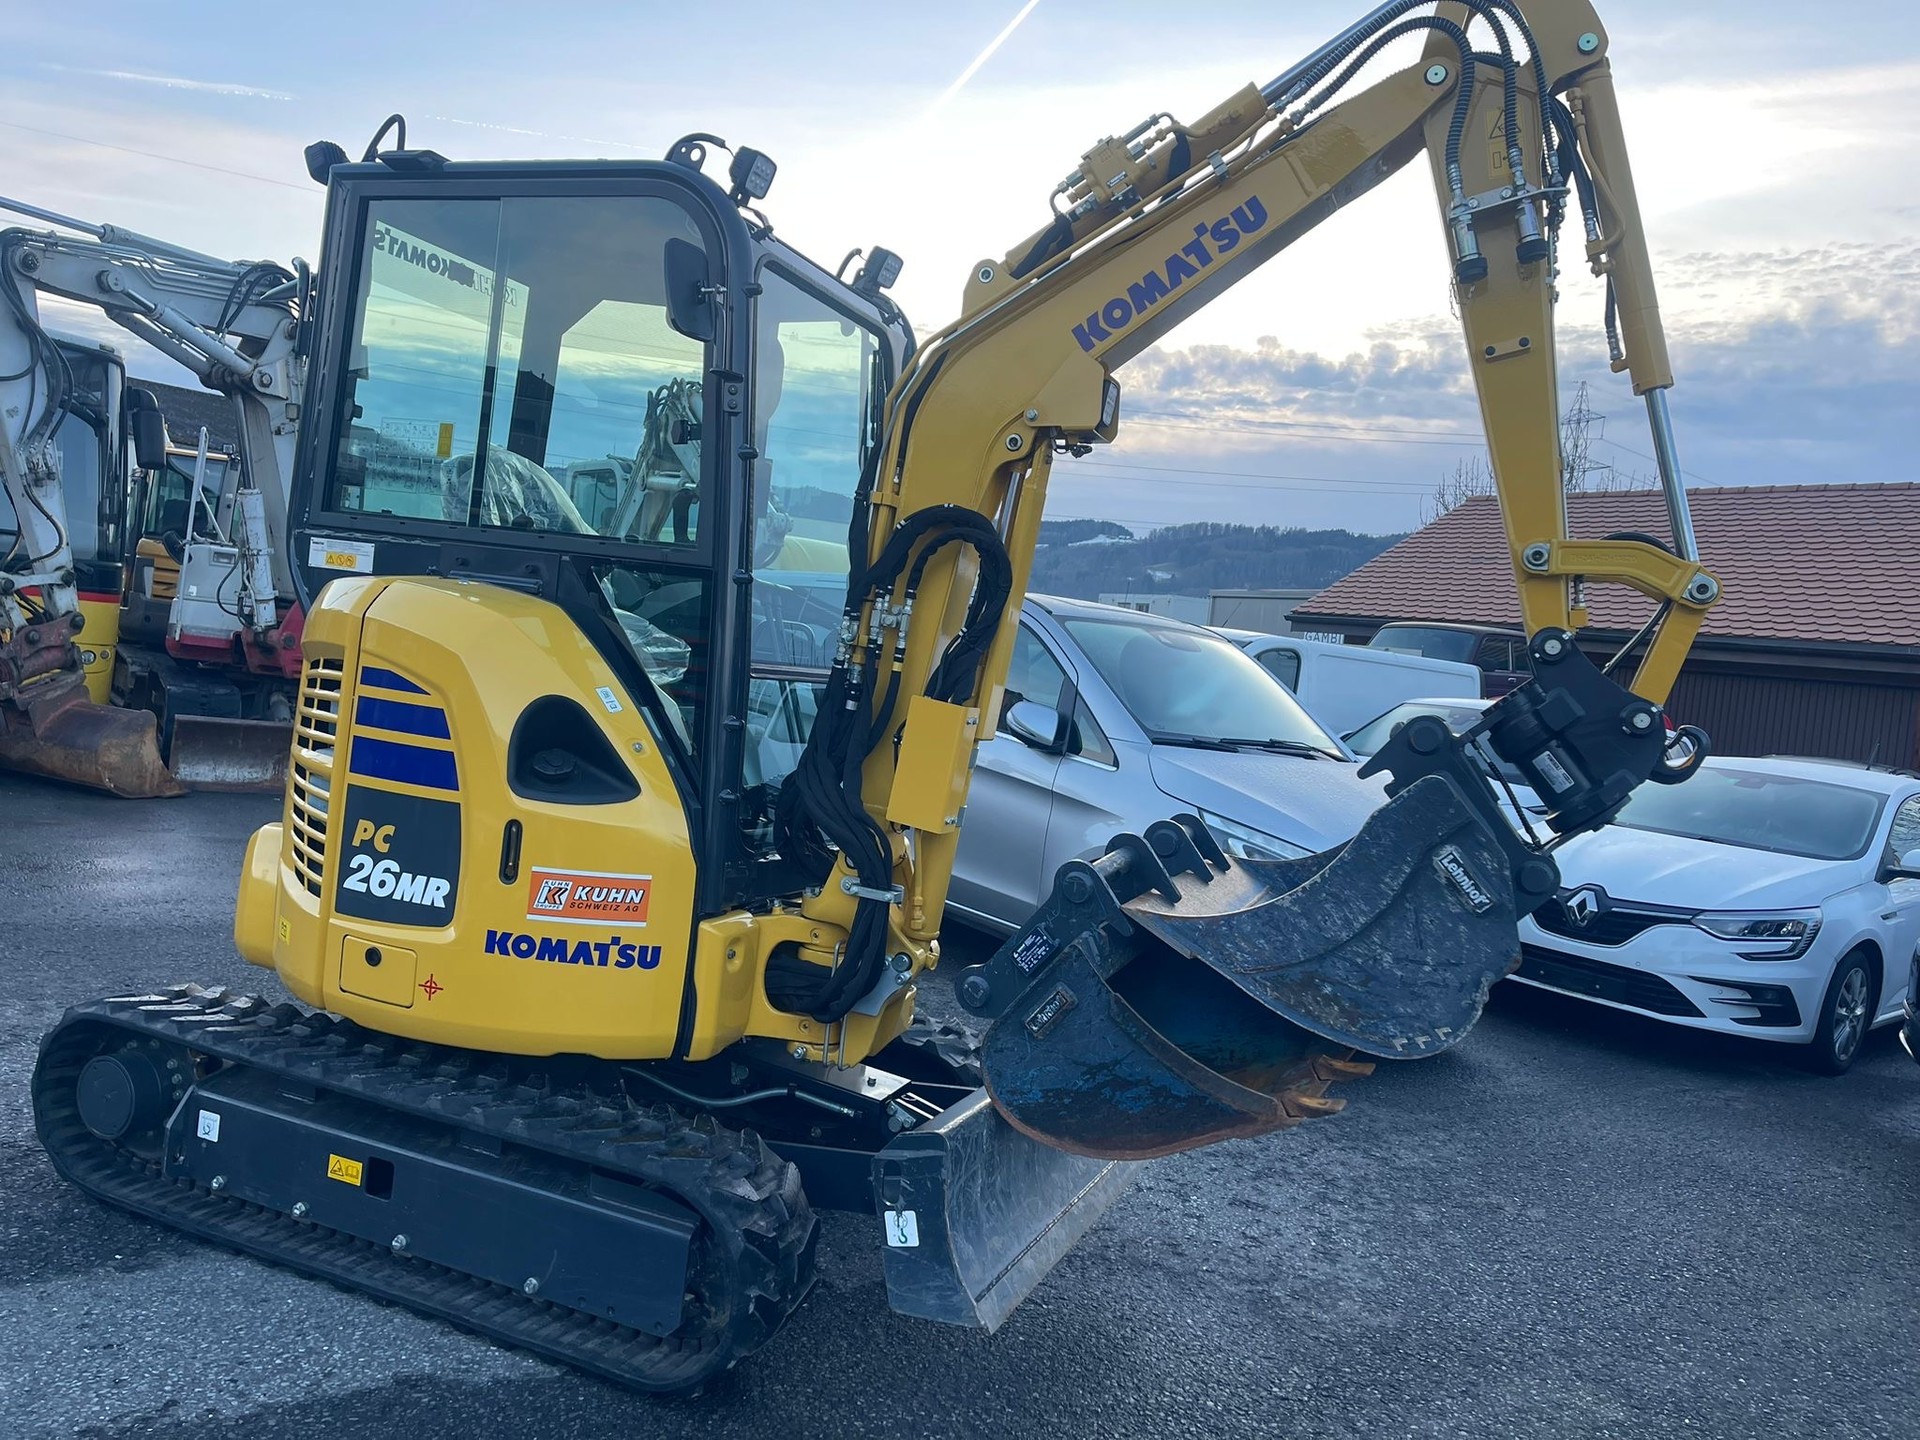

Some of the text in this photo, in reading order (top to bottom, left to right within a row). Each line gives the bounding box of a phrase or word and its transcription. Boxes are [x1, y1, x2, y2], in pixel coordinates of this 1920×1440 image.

[1071, 195, 1269, 353] KOMATSU
[351, 818, 396, 853] PC
[343, 854, 451, 908] 26MR
[573, 885, 646, 904] KUHN
[569, 901, 621, 912] SCHWEIZ
[484, 929, 662, 970] KOMATSU
